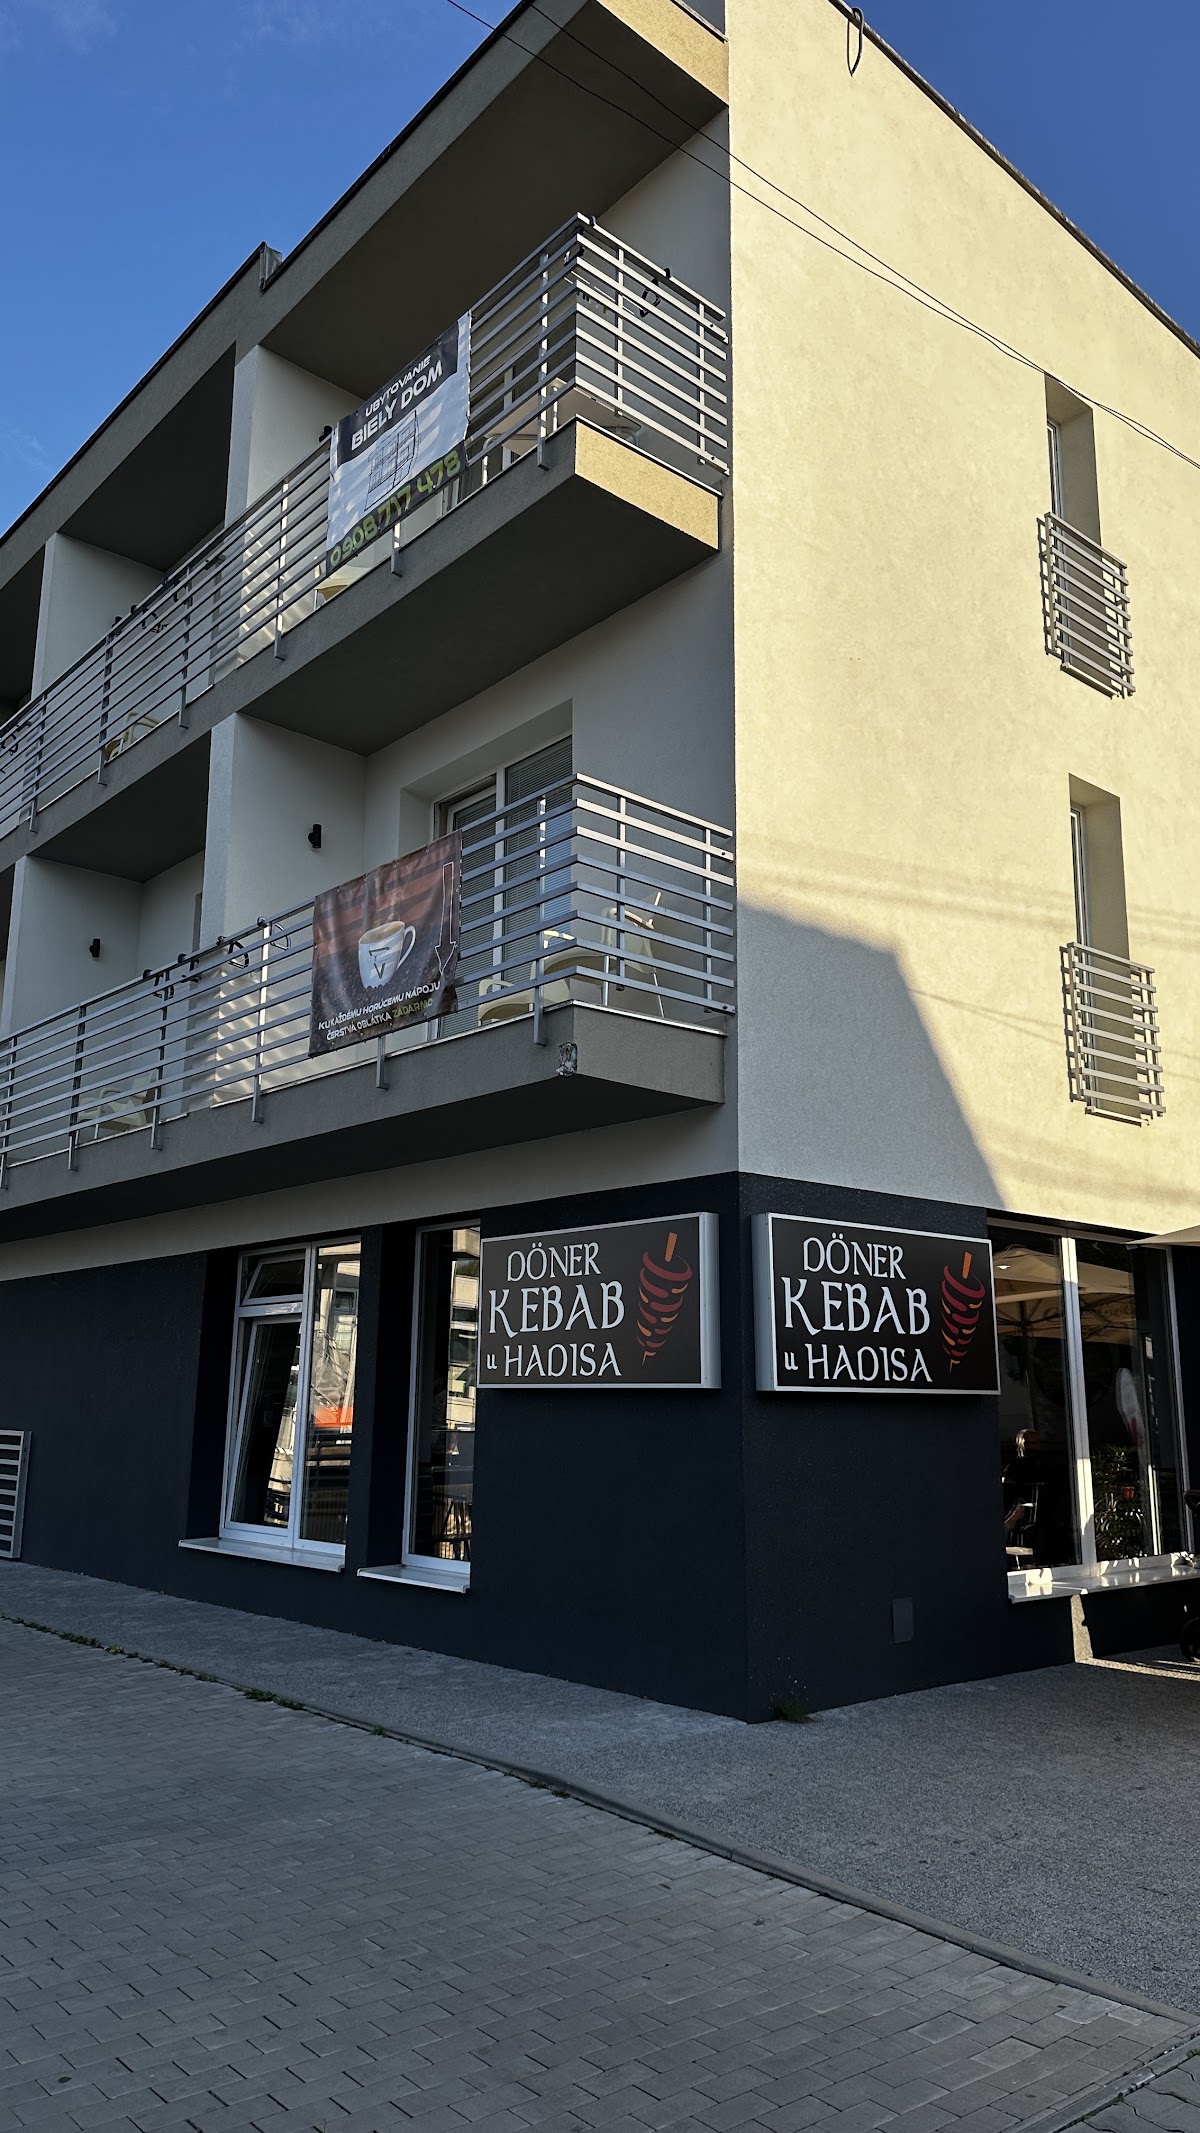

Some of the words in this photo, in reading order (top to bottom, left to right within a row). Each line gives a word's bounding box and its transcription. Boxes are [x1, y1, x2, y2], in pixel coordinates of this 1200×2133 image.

[351, 398, 398, 451] BIELY
[401, 360, 443, 409] DOM
[365, 354, 431, 417] UBYTOVANIE
[330, 515, 379, 567] 0908
[378, 484, 411, 527] 717
[417, 450, 461, 494] 478
[326, 1022, 357, 1041] ČERSTVÁ
[357, 1012, 392, 1029] OBLÁTKA
[391, 998, 433, 1019] ZADARMO
[362, 994, 405, 1014] HORÚCEMU
[405, 980, 441, 1001] NÁPOJU
[507, 1241, 602, 1282] DÖNER
[803, 1232, 906, 1280] DÖNER
[488, 1280, 625, 1339] KEBAB
[780, 1276, 931, 1336] KEBAB
[486, 1353, 498, 1370] u
[503, 1342, 622, 1377] HADISA
[784, 1351, 799, 1371] u
[804, 1343, 933, 1382] HADISA
